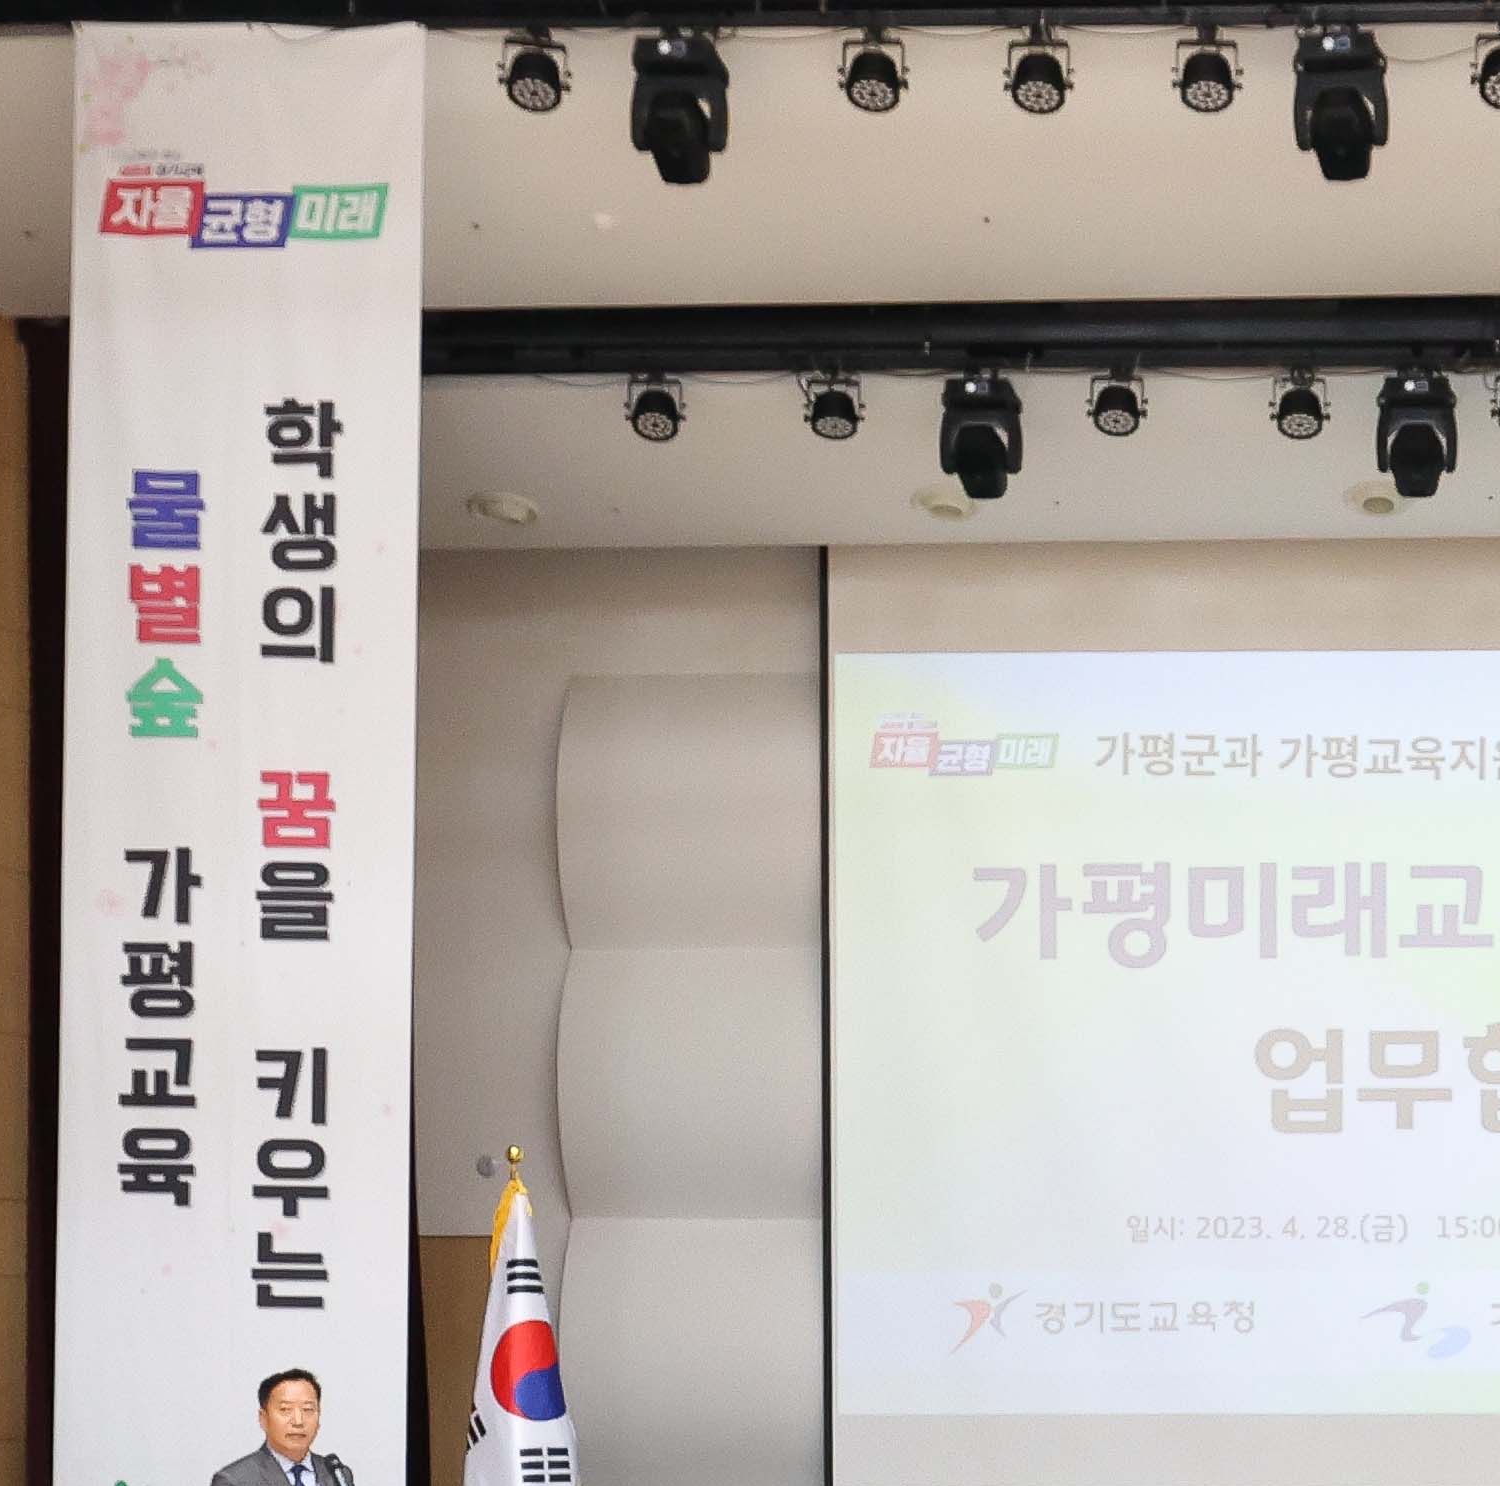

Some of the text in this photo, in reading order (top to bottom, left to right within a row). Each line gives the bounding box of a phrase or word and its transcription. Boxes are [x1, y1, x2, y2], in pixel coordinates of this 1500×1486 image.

[106, 182, 193, 231] 자율
[295, 189, 381, 234] 미래
[1095, 732, 1262, 778] 가평군과
[118, 470, 205, 1207] 물별숲 가평교육
[251, 398, 343, 1309] 학생의 꿈을 키우는
[1126, 1214, 1185, 1244] 일시:
[1195, 1215, 1269, 1241] 2023.
[1281, 1215, 1306, 1240] 4.
[1316, 1214, 1408, 1243] 28.(금)
[1035, 1300, 1255, 1335] 경기도교육청
